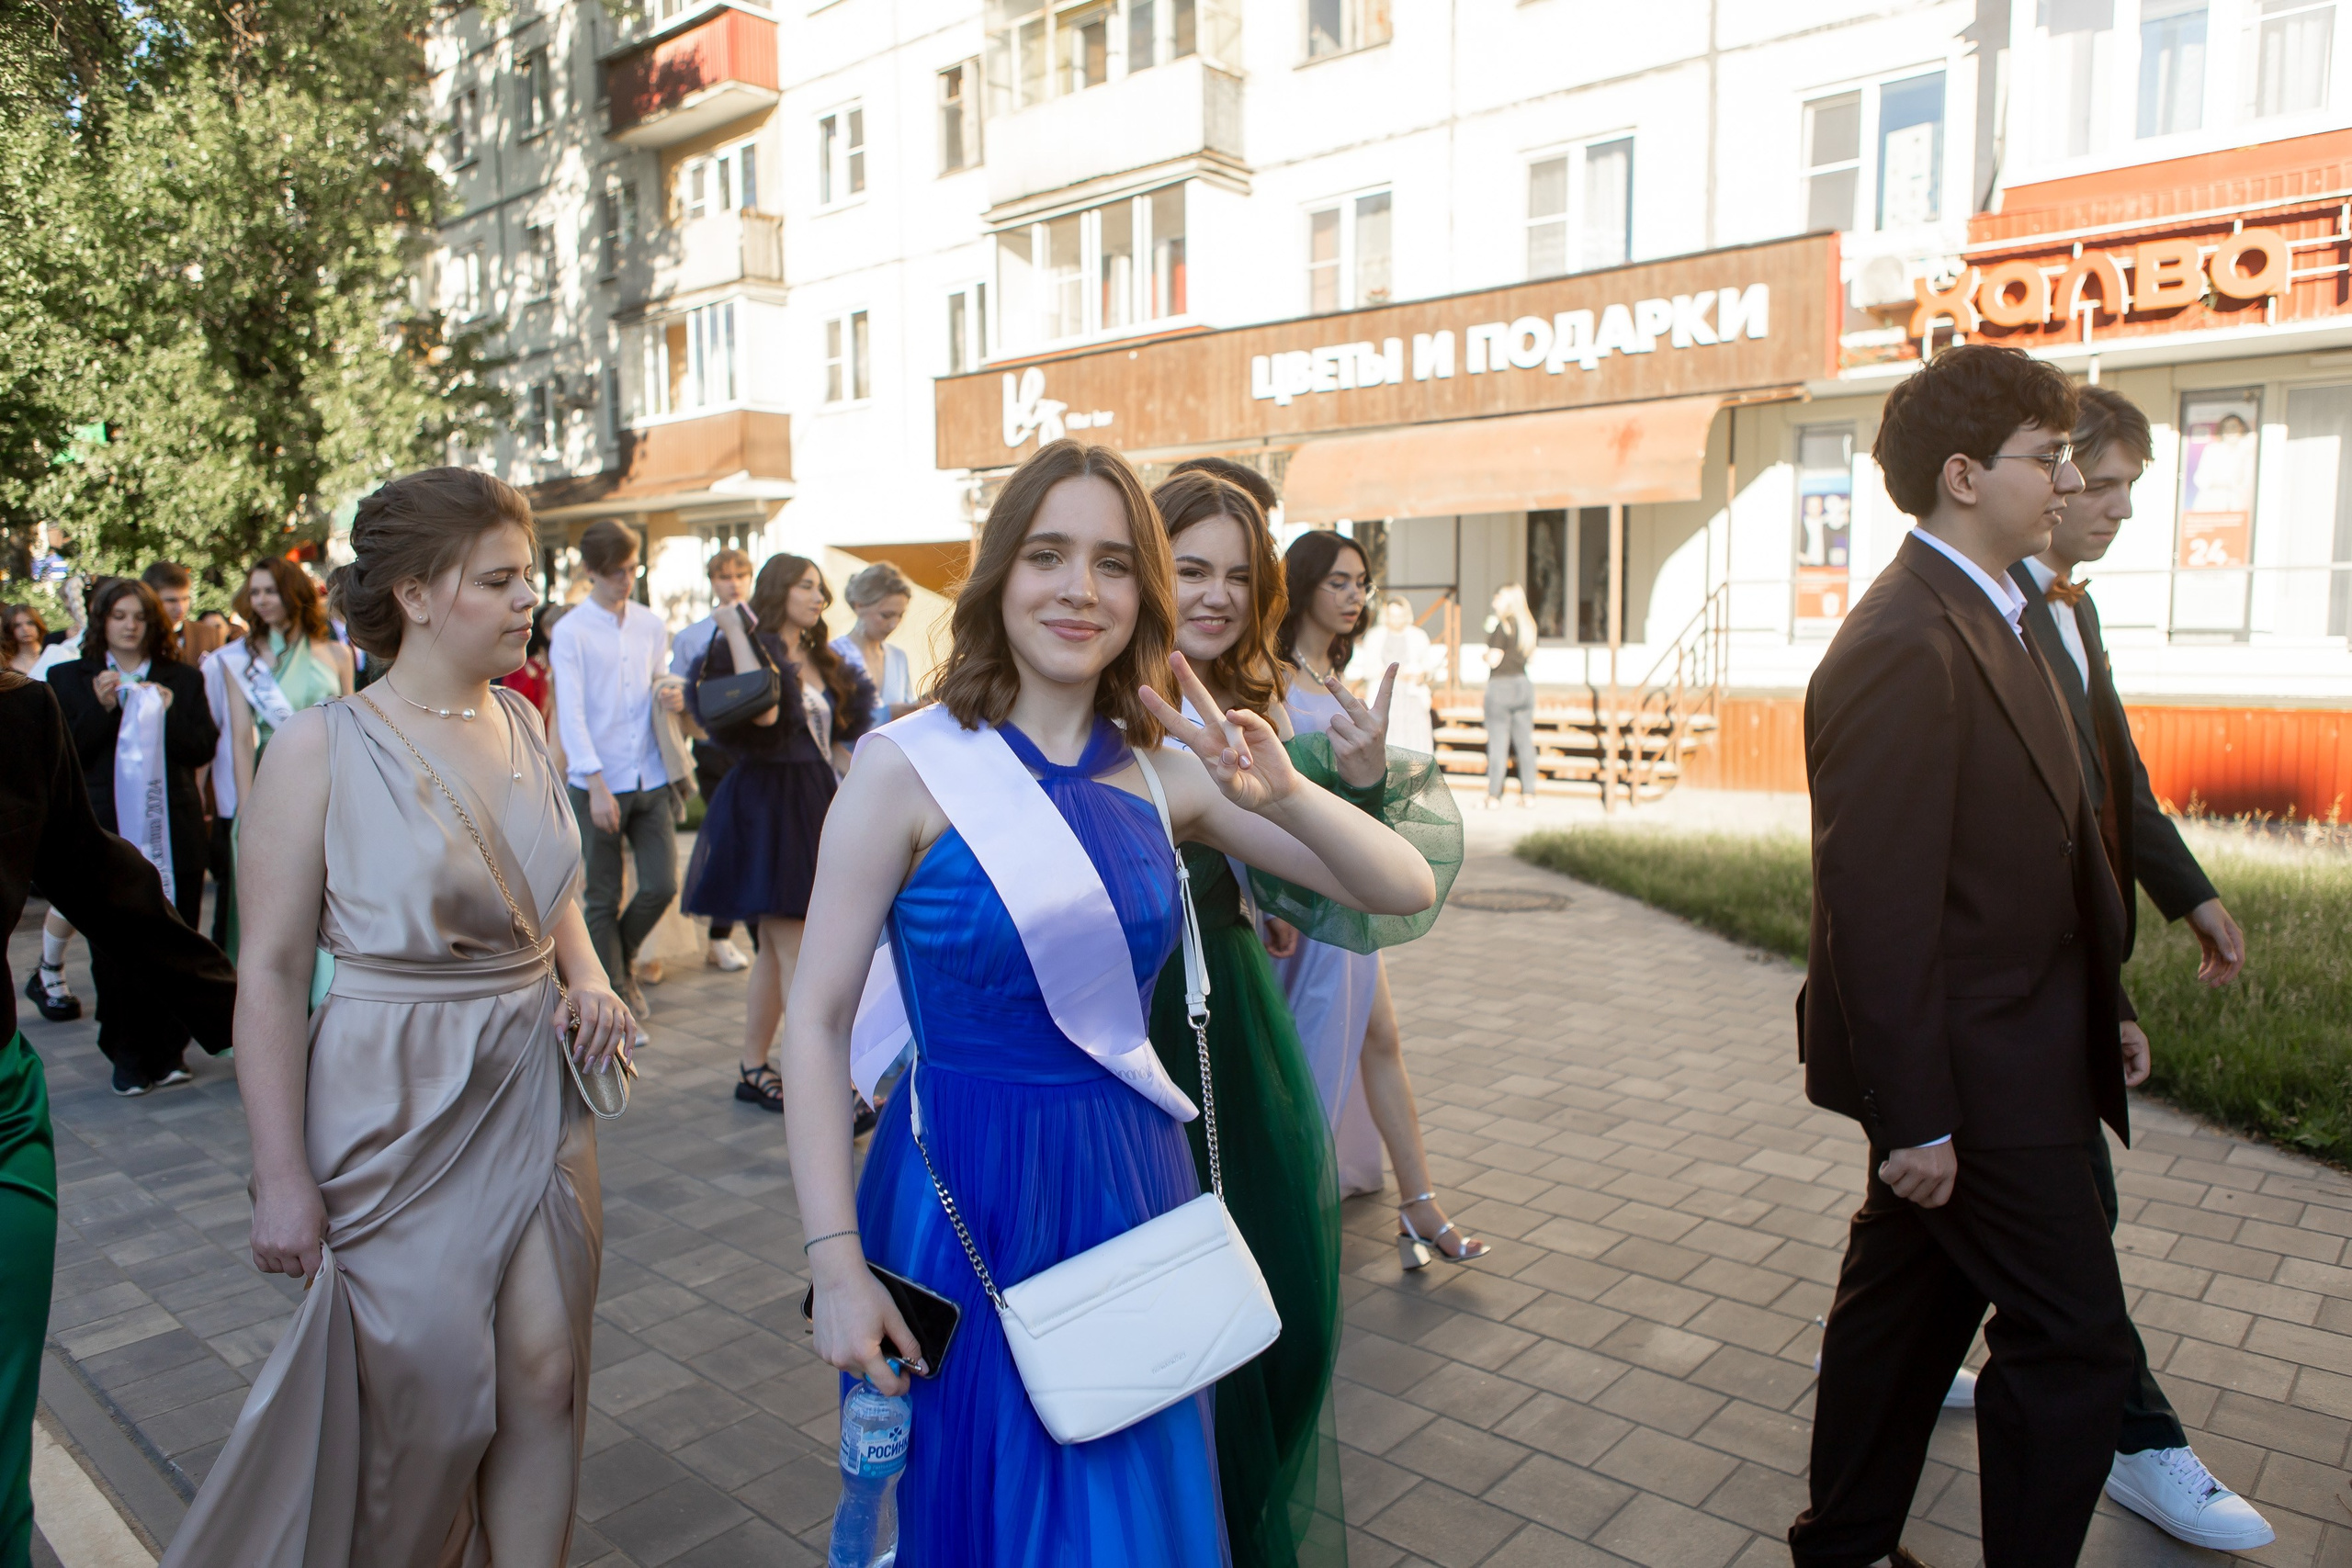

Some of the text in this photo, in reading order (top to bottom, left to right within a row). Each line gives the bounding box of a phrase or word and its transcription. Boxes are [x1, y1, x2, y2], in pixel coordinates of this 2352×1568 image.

[1251, 282, 1770, 406] ЦВЕТЫ И ПОДАРКИ
[145, 779, 164, 818] 2024
